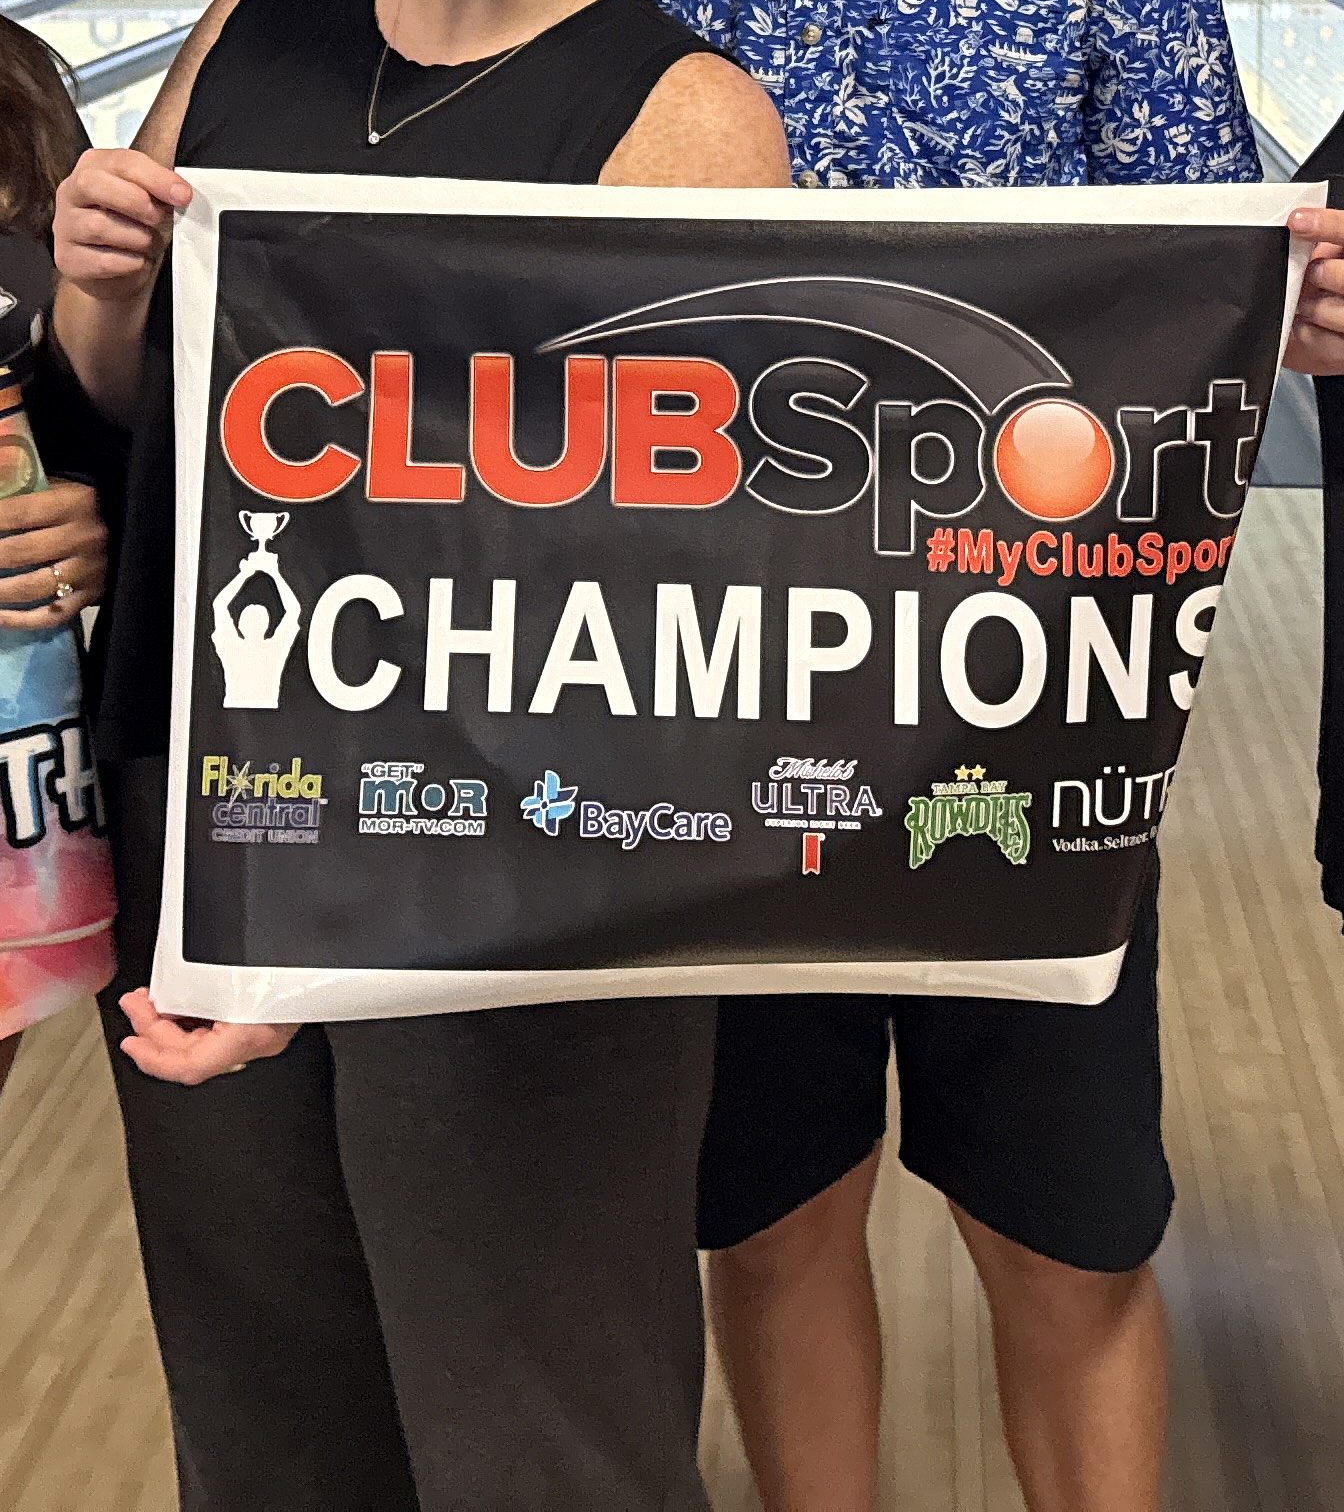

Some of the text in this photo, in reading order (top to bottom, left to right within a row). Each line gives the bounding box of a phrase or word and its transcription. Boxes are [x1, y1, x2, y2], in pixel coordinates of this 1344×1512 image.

[927, 527, 1236, 587] #MyClubSpor
[751, 781, 880, 816] ULTRA
[931, 781, 1007, 795] TAMPA BAY
[212, 798, 320, 828] central
[359, 819, 485, 836] MOR-TV.COM
[580, 801, 732, 850] BayCare
[905, 792, 1033, 869] ROWDIES
